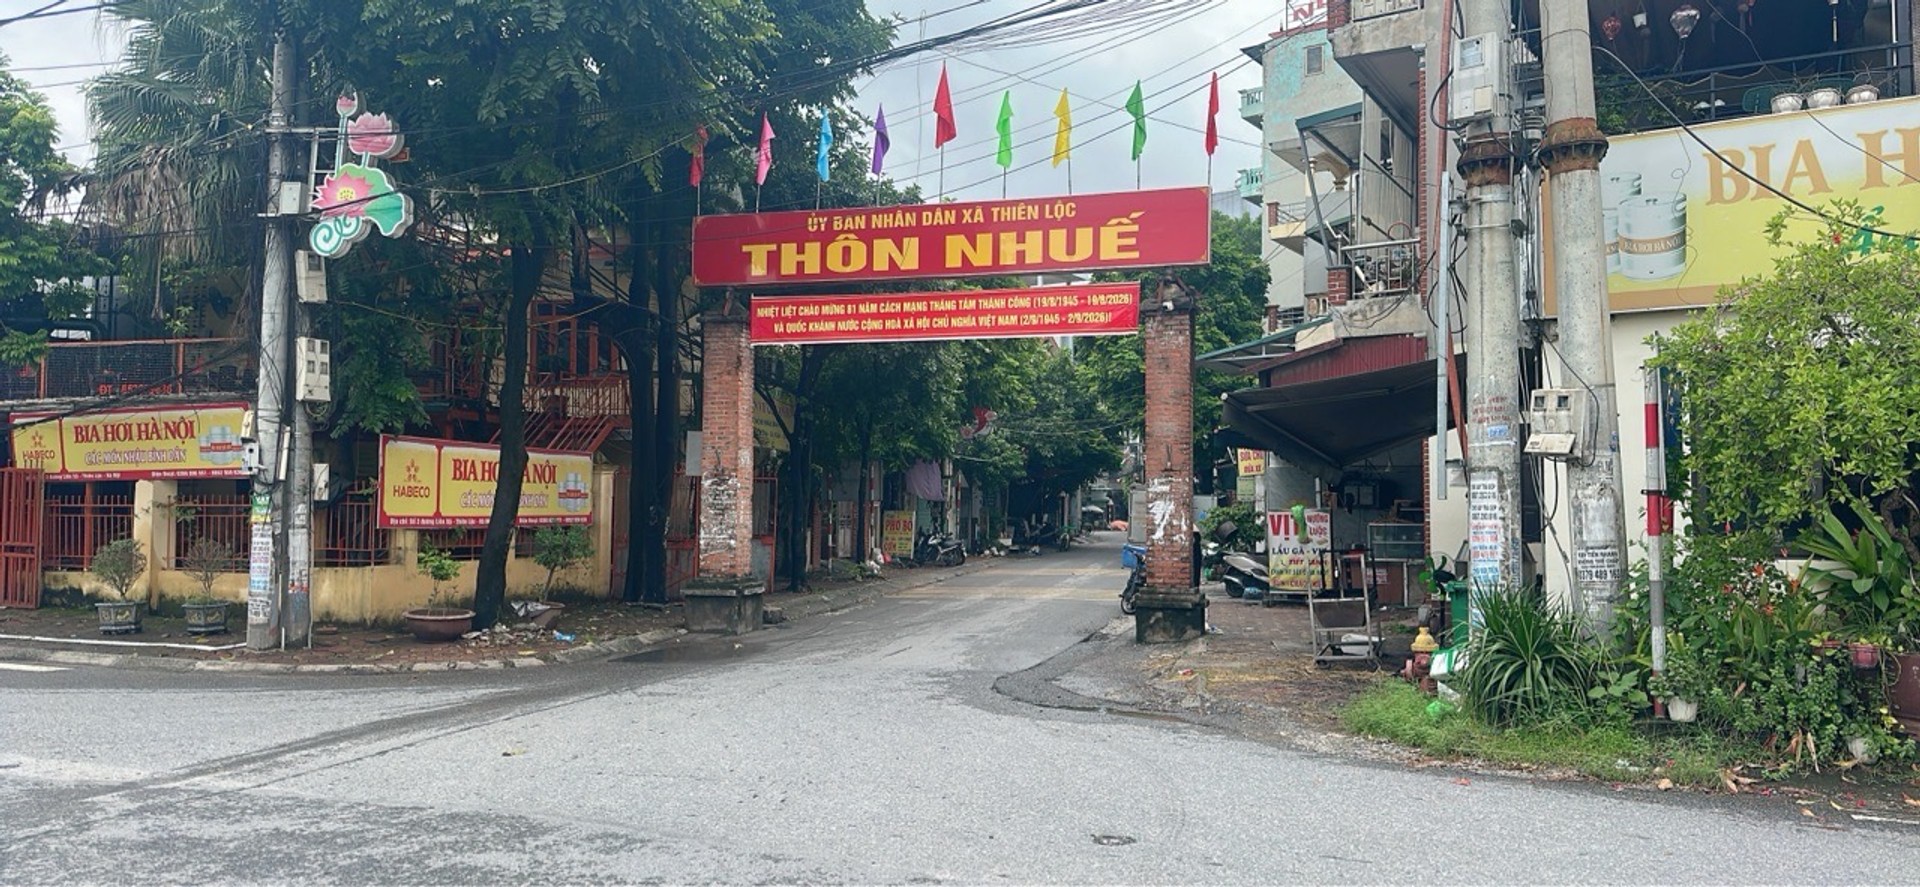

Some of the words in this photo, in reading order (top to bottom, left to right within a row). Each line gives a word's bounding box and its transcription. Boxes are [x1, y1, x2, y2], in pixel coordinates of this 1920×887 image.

[1702, 139, 1834, 205] BIA
[808, 212, 828, 232] ỦY
[833, 215, 866, 231] BAN
[871, 209, 917, 229] NHÂN
[922, 207, 956, 226] DÂN
[962, 206, 984, 224] XÃ
[991, 202, 1040, 222] THIÊN
[1044, 200, 1077, 221] LỘC
[742, 233, 920, 277] THÔN
[945, 211, 1145, 269] NHUẾ
[757, 304, 779, 319] NHIỆT
[781, 304, 797, 319] LIỆT
[798, 303, 820, 317] CHÀO
[821, 302, 846, 316] MỪNG
[858, 301, 878, 314] NĂM
[879, 300, 901, 313] CÁCH
[903, 301, 928, 315] MẠNG
[930, 298, 957, 312] THÁNG
[959, 297, 976, 311] TÁM
[978, 296, 1006, 310] THÀNH
[1008, 295, 1032, 309] CÔNG
[774, 321, 785, 334] VÀ
[786, 319, 807, 334] QUỐC
[808, 319, 836, 332] KHÁNH
[837, 318, 860, 332] NƯỚC
[861, 317, 883, 332] CỘNG
[885, 317, 902, 330] HOÀ
[903, 316, 915, 329] XÃ
[916, 316, 931, 331] HỘI
[932, 315, 950, 329] CHỦ
[950, 314, 976, 328] NGHĨA
[978, 313, 997, 329] VIỆT
[998, 314, 1018, 326] NAM
[74, 424, 101, 444] BIA
[102, 422, 134, 442] HƠI
[136, 416, 161, 442] HÀ
[163, 415, 196, 445] NỘI
[22, 449, 55, 460] HABECO
[85, 449, 101, 466] CÁC
[452, 458, 479, 482] BIA
[533, 459, 557, 489] NỘI
[393, 485, 430, 498] HABECO
